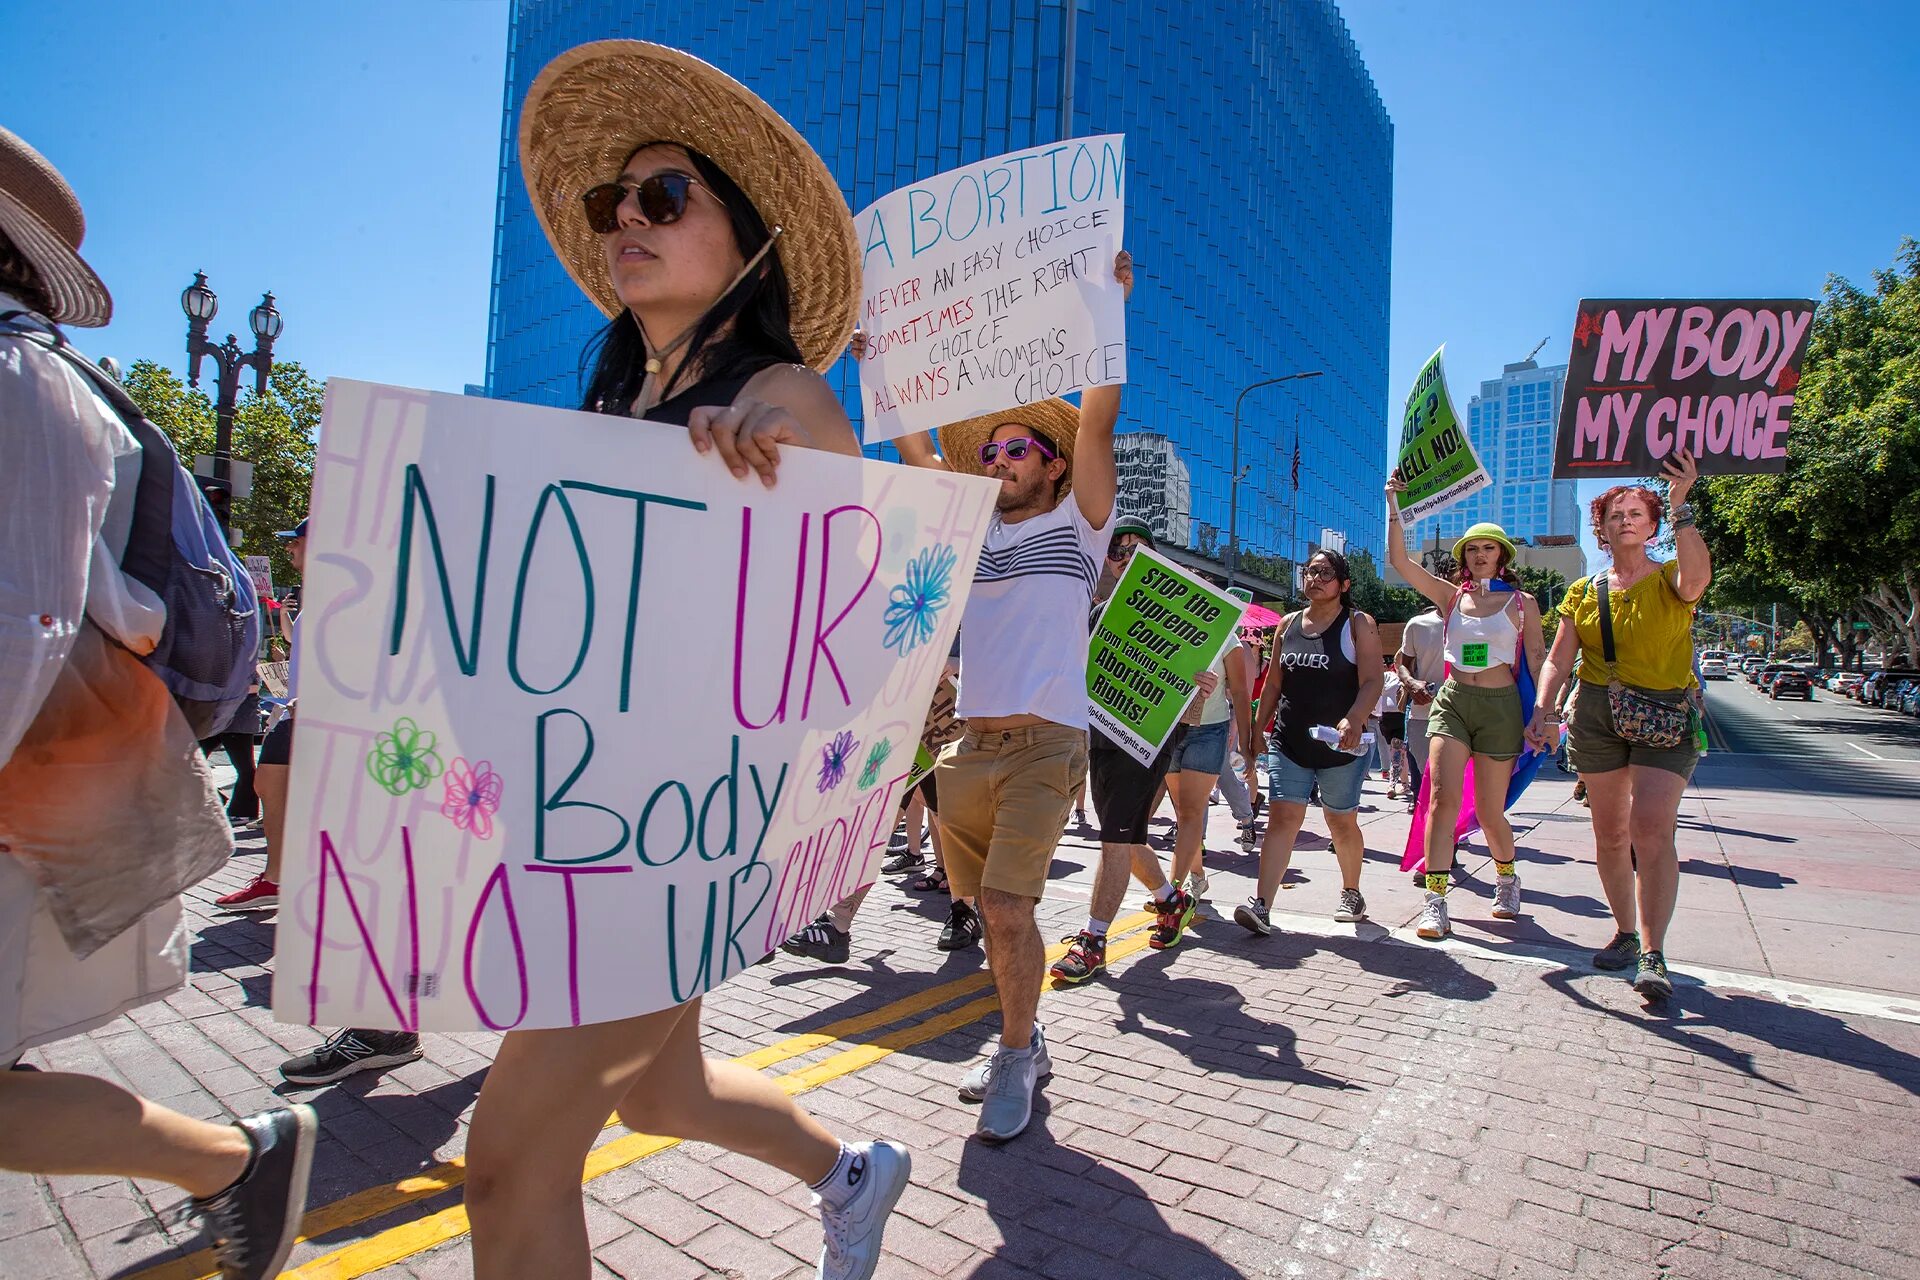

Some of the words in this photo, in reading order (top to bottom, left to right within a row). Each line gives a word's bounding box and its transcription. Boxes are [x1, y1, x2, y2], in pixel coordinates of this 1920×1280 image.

[862, 136, 1126, 270] ABORTION
[867, 277, 921, 321] NEVER
[933, 262, 954, 296] AN
[964, 243, 1003, 282] EASY
[1015, 209, 1110, 259] CHOICE
[867, 296, 974, 361] SOMETIMES
[981, 278, 1023, 317] THE
[1033, 246, 1097, 297] RIGHT
[874, 366, 949, 418] ALWAYS
[957, 359, 974, 392] A
[974, 328, 1067, 379] WOMEN'S
[929, 316, 1009, 366] CHOICE
[1015, 343, 1124, 405] CHOICE
[1593, 308, 1677, 382] MY
[1671, 306, 1813, 388] BODY
[1430, 424, 1464, 464] NO!
[1573, 392, 1642, 462] MY
[1646, 390, 1795, 461] CHOICE
[389, 463, 707, 713] NOT
[733, 504, 883, 730] UR
[1126, 589, 1209, 649] Supreme
[1140, 567, 1189, 601] STOP
[1183, 592, 1222, 624] the
[1096, 624, 1122, 650] from
[1122, 640, 1161, 674] taking
[1157, 665, 1195, 697] away
[1127, 620, 1182, 661] Court
[1280, 652, 1330, 672] POWER
[1091, 673, 1150, 726] Rights!
[1095, 646, 1167, 707] Abortion
[1088, 704, 1151, 760] Up4AbortionRights.org
[535, 708, 789, 883] Body
[310, 825, 633, 1032] NOT
[667, 861, 773, 1003] UR
[765, 772, 912, 953] CHOICE
